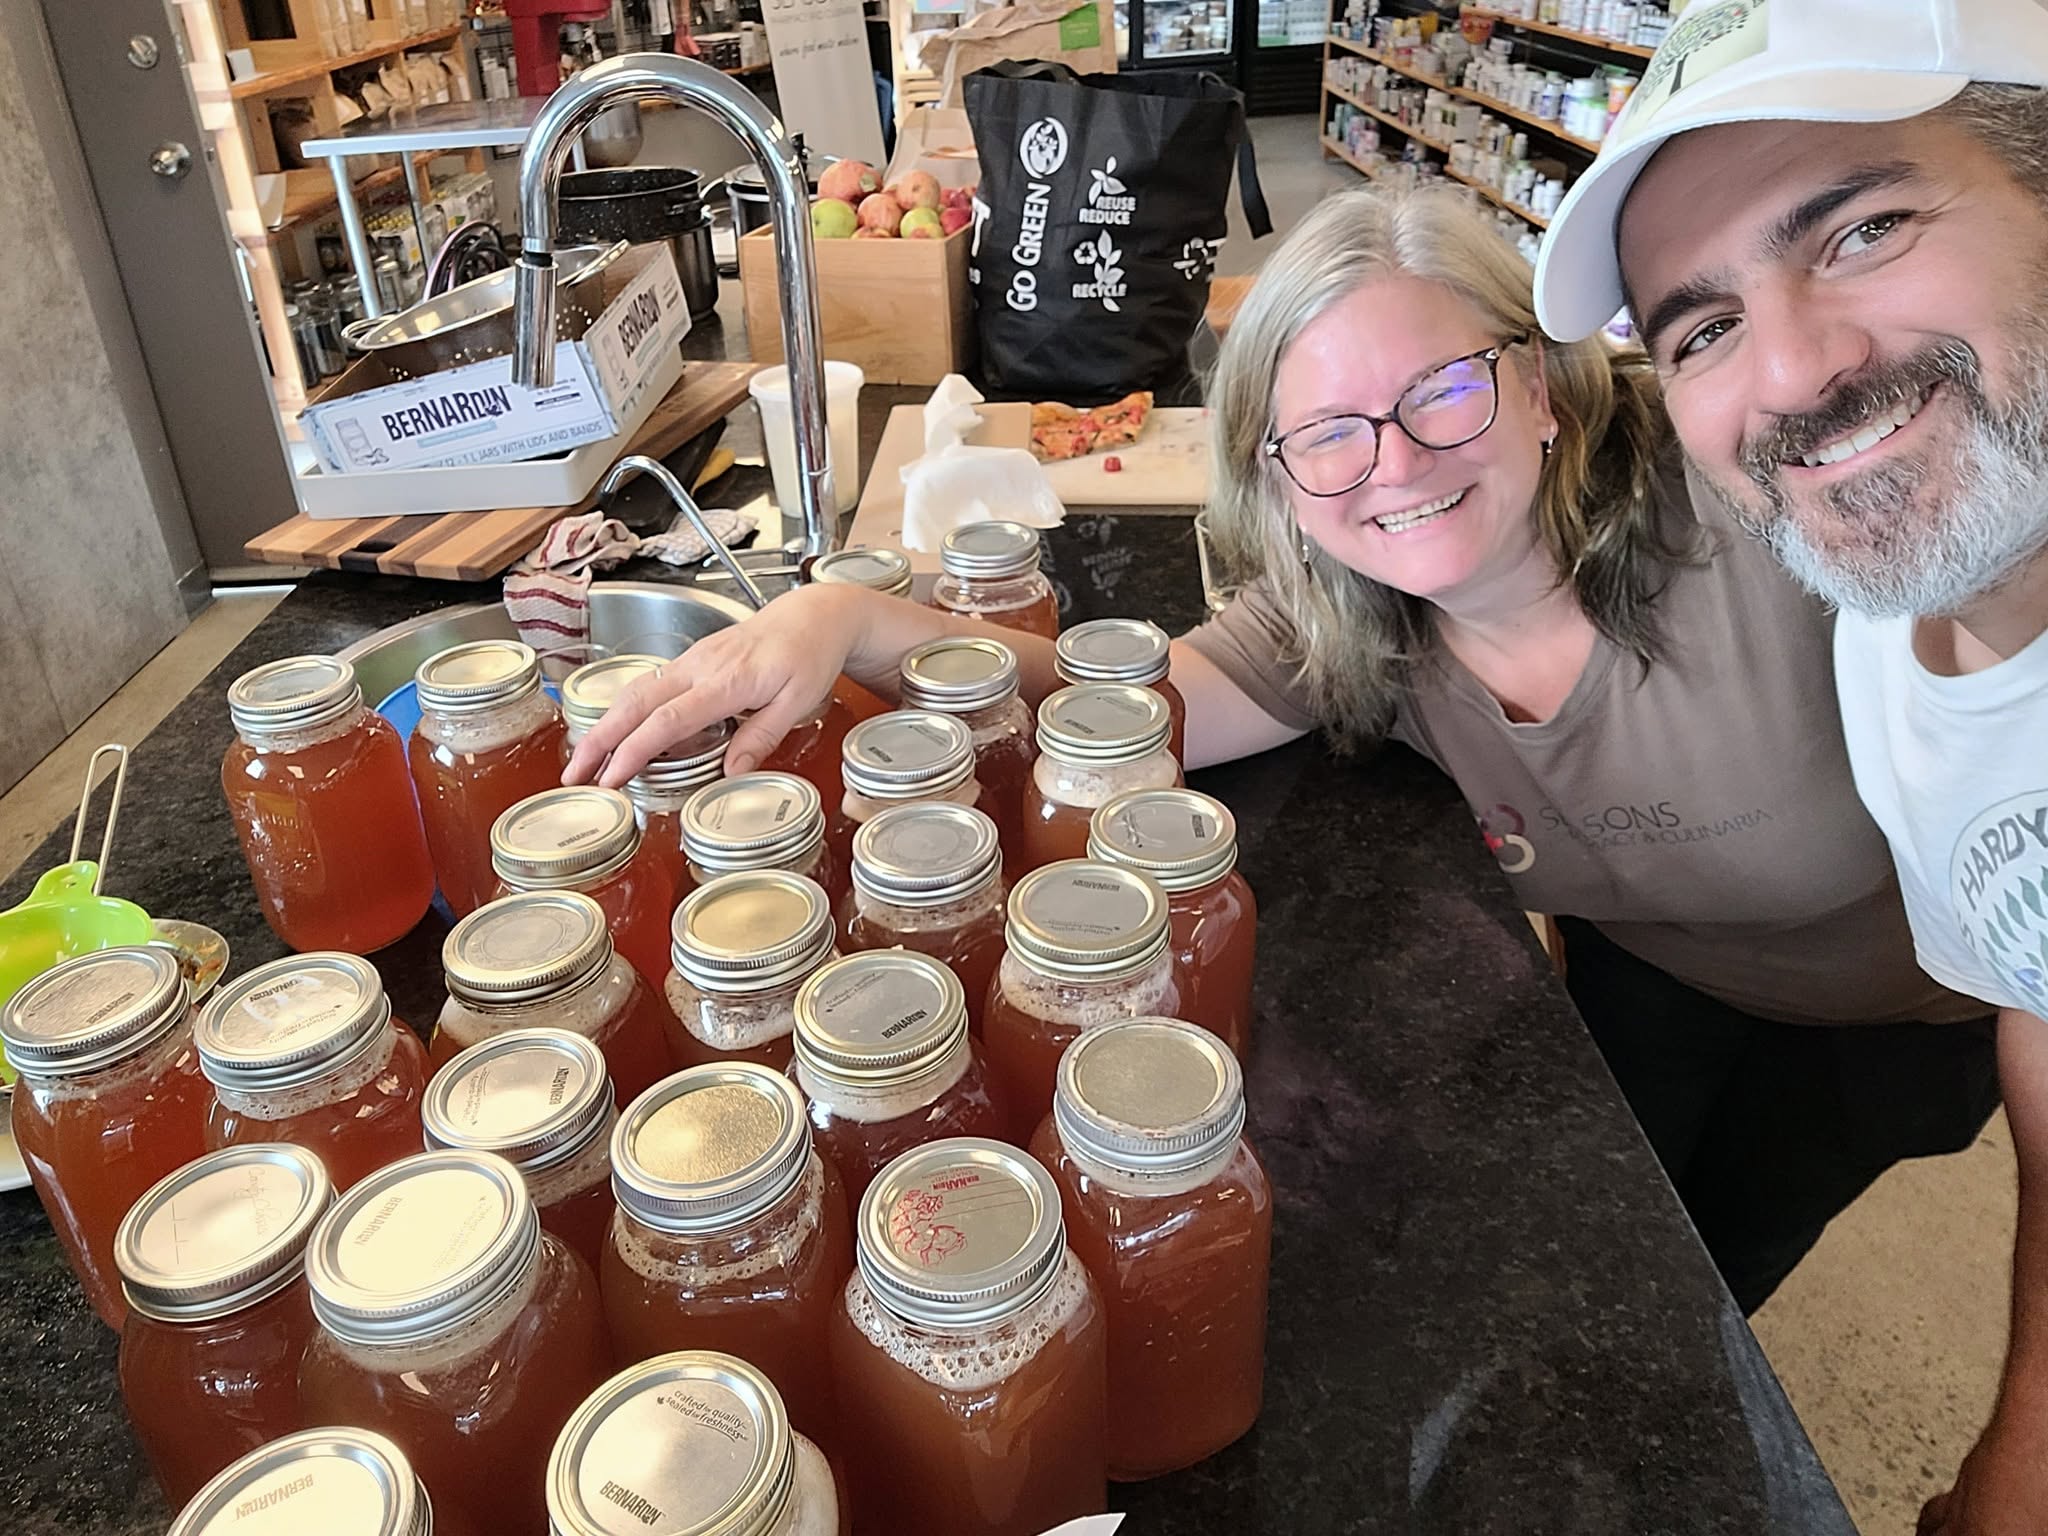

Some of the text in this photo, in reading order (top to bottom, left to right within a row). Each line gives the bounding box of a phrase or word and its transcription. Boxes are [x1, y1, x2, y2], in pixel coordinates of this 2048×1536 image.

[1079, 208, 1131, 225] REDUCE
[1096, 196, 1136, 211] REUSE
[1006, 182, 1051, 312] GO GREEN
[1072, 283, 1127, 298] RECYCLE
[382, 385, 512, 442] BERNARDIN
[479, 446, 500, 461] JARS
[501, 441, 526, 455] WITH
[527, 435, 547, 449] LIDS
[549, 430, 569, 443] AND
[570, 421, 603, 438] BANDS
[1960, 806, 2048, 912] HARDY
[881, 1009, 928, 1039] BERNARDIN
[666, 1397, 693, 1416] sealed
[699, 1414, 741, 1440] freshness
[674, 1390, 705, 1410] crafted
[711, 1409, 743, 1428] quality
[236, 1474, 314, 1520] BERNARDIN
[600, 1480, 662, 1526] BERNARDIN
